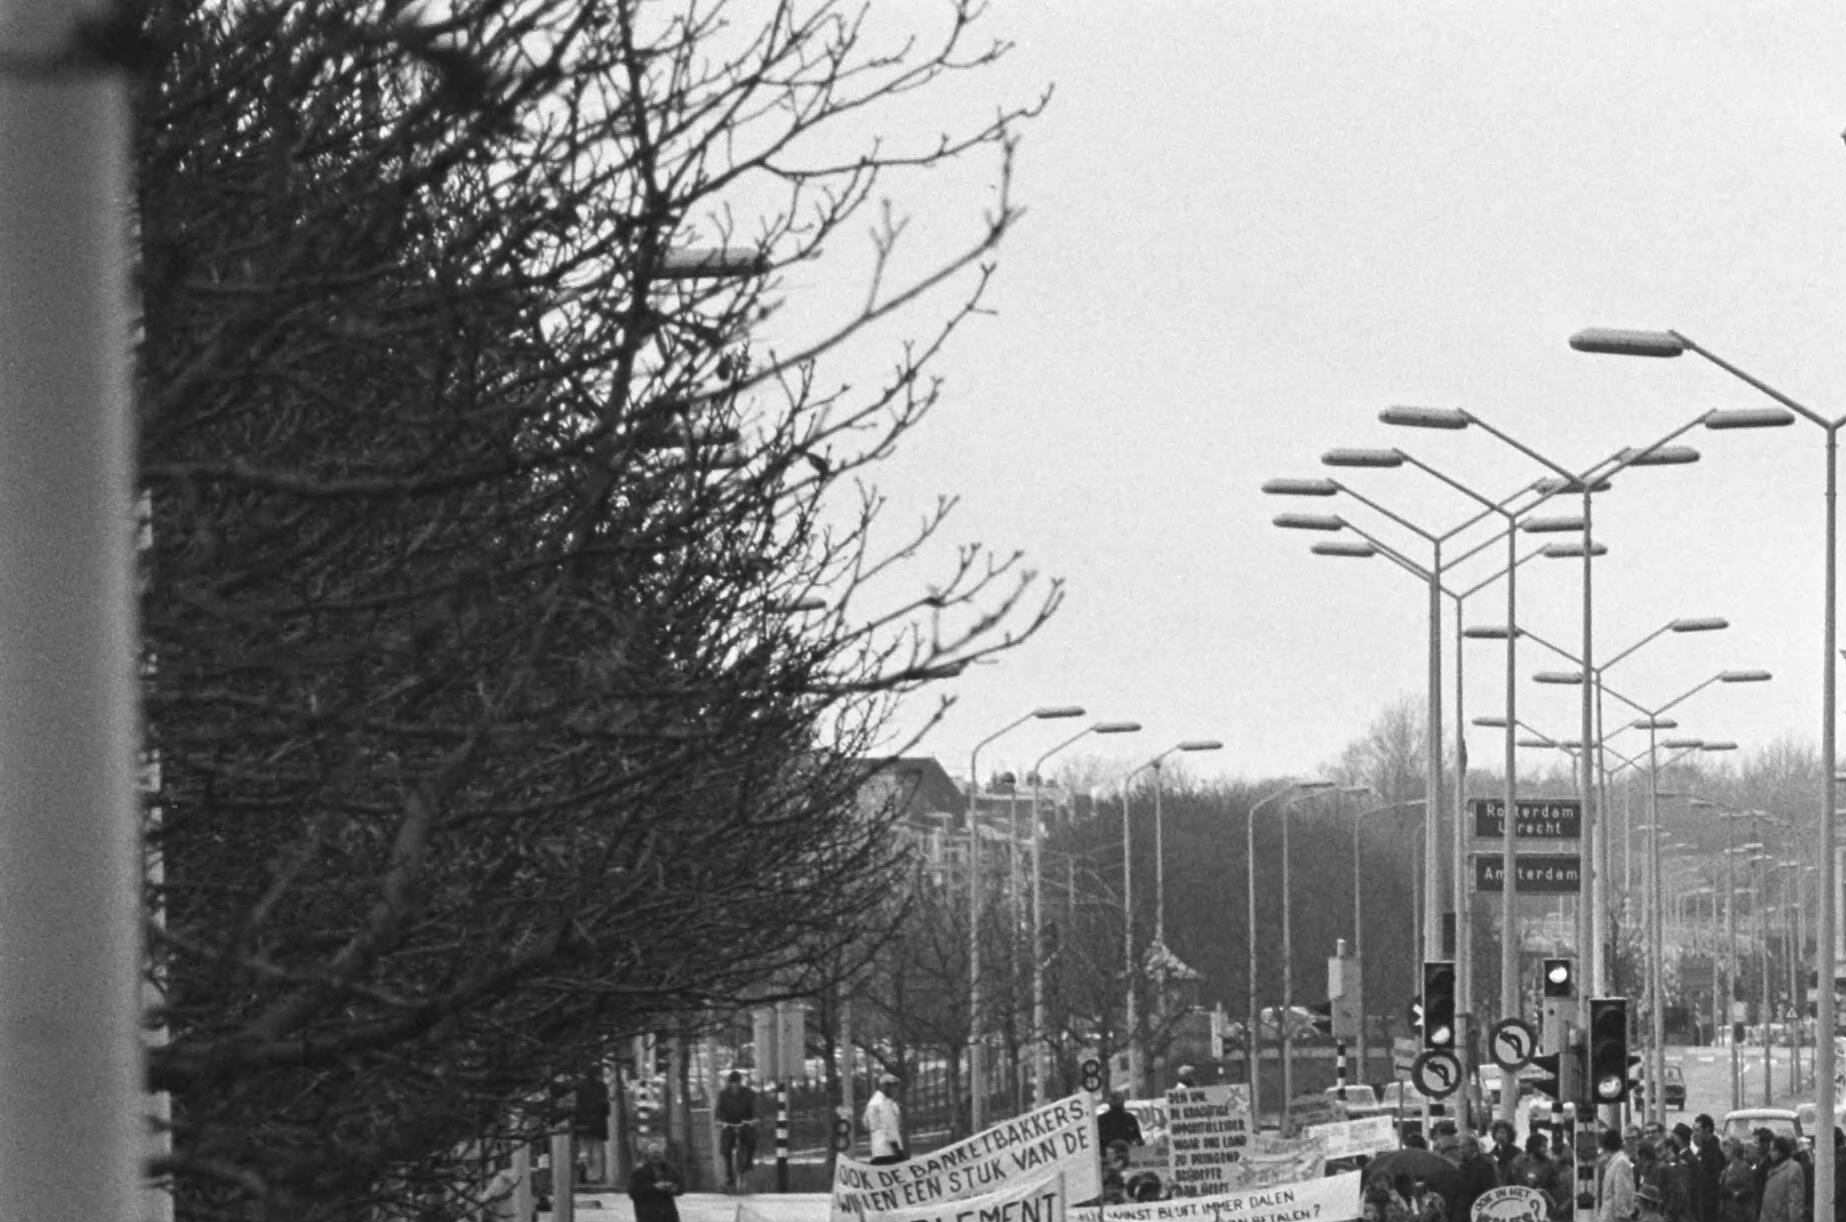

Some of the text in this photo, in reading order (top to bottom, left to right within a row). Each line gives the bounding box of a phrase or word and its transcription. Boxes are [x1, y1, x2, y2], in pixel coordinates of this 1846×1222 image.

[1487, 803, 1574, 818] Roterdam
[1485, 866, 1578, 880] Amterdam
[904, 1177, 942, 1206] EEN
[949, 1158, 1008, 1193] STUK
[1012, 1138, 1059, 1171] VAN
[1062, 1126, 1090, 1155] DE
[839, 1164, 874, 1190] OOK
[878, 1170, 907, 1187] DE
[1250, 1189, 1294, 1208] DALEN
